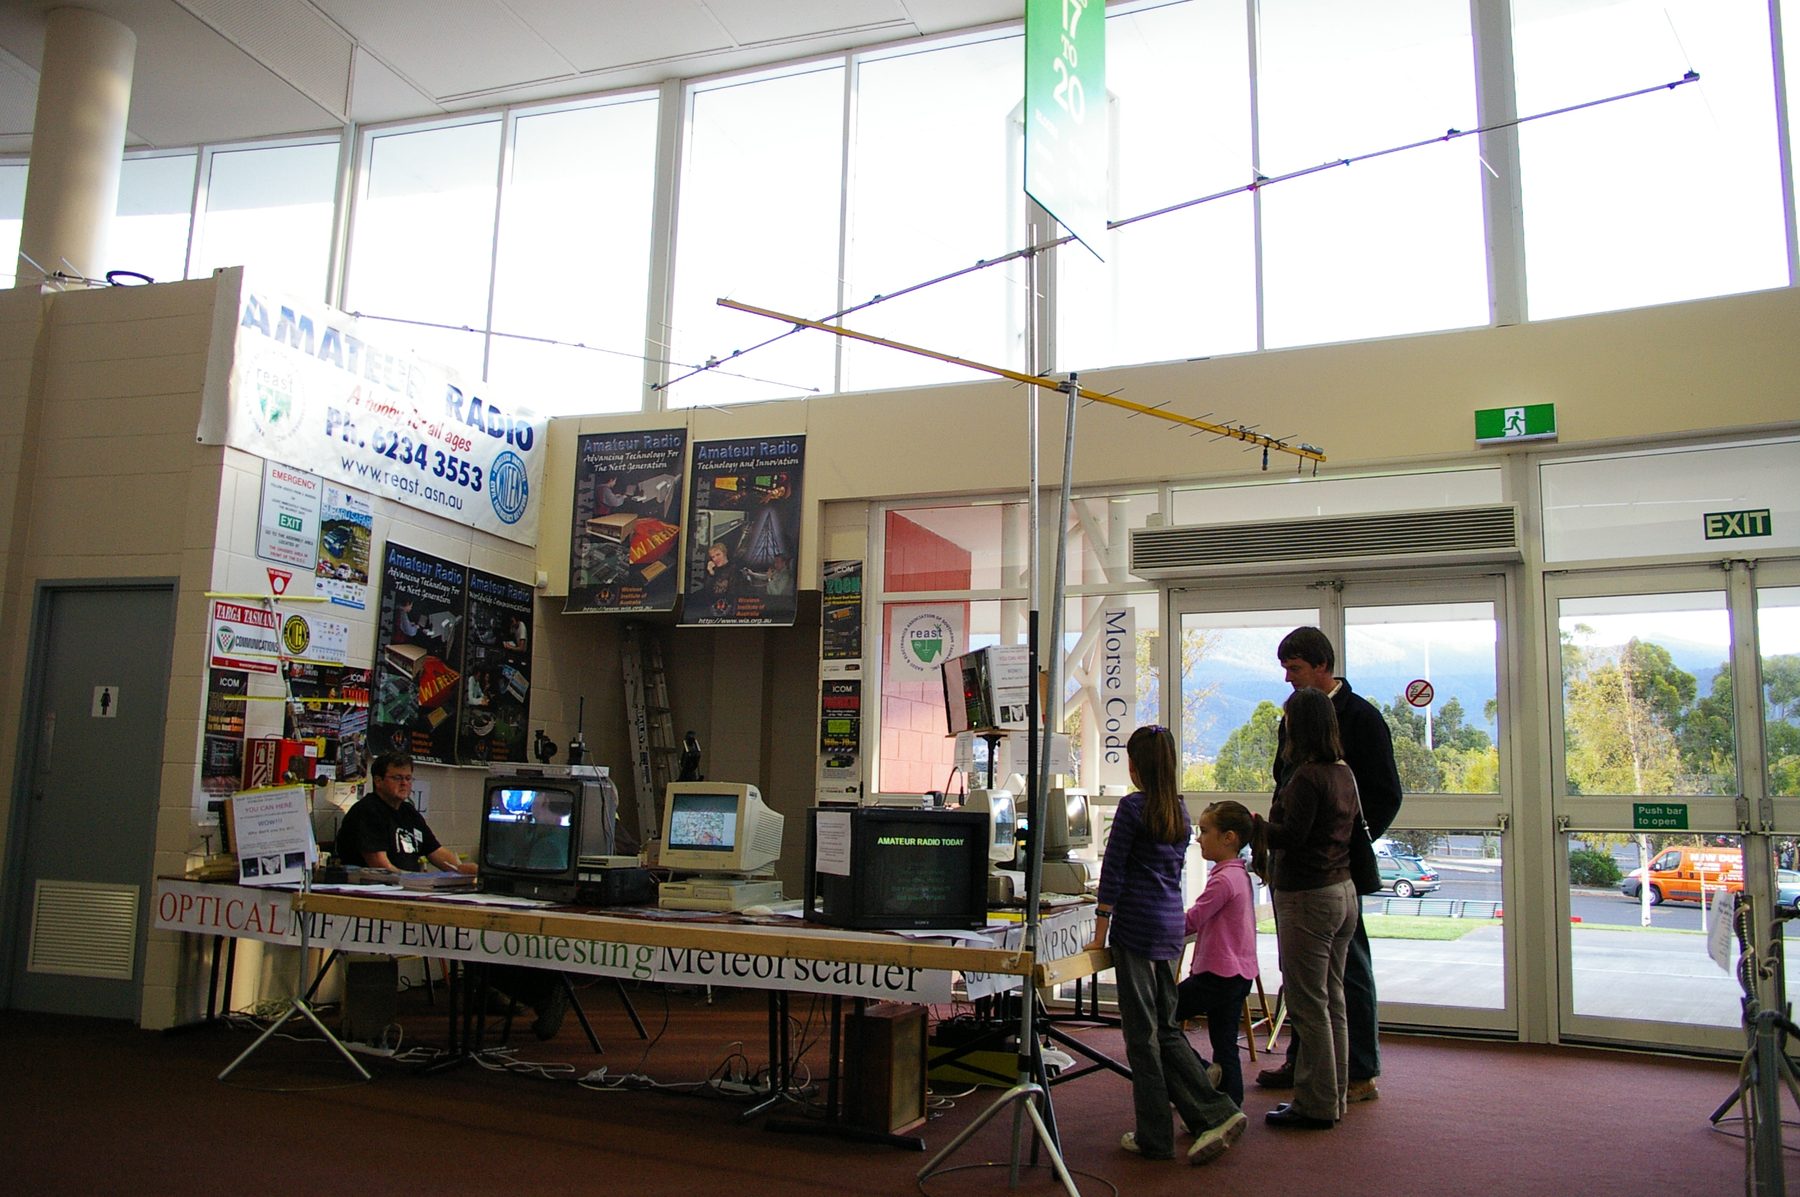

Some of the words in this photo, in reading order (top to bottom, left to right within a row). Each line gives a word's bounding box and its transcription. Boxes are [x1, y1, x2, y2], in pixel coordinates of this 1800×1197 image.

[447, 383, 534, 451] RADIO
[325, 406, 365, 448] Ph.
[372, 426, 427, 470] 6234
[433, 450, 483, 492] 3553
[445, 431, 472, 452] ages
[584, 438, 640, 452] Amateur
[644, 434, 682, 449] Radio
[698, 444, 756, 460] Amateur
[760, 441, 799, 456] Radio
[584, 452, 624, 464] Advancing
[625, 450, 666, 463] Technology
[667, 450, 680, 458] For
[697, 460, 738, 473] Technology
[740, 458, 755, 470] and
[755, 456, 799, 467] Innovation
[594, 464, 608, 472] The
[608, 463, 626, 471] Next
[626, 462, 668, 474] Generation
[272, 469, 316, 490] EMERGENCY
[340, 456, 463, 511] www.reast.asn.au
[280, 513, 302, 530] EXIT
[1705, 511, 1770, 538] EXIT
[388, 548, 433, 576] Amateur
[435, 562, 462, 584] Radio
[388, 566, 420, 588] Advancing
[420, 576, 451, 597] Technology
[451, 585, 460, 596] For
[470, 574, 506, 595] Amateur
[508, 584, 530, 602] Radio
[395, 581, 406, 592] The
[406, 585, 421, 596] Next
[421, 590, 451, 604] Generation
[216, 604, 241, 624] TARGA
[910, 628, 943, 638] reast
[1105, 609, 1127, 690] Morse
[1105, 698, 1128, 764] Code
[260, 804, 274, 812] CAN
[276, 802, 292, 810] HERE
[1638, 804, 1664, 816] Push
[1667, 806, 1684, 816] bar
[1638, 816, 1648, 826] to
[1650, 817, 1678, 828] open
[877, 836, 916, 846] AMATEUR
[917, 838, 940, 846] RADIO
[158, 890, 287, 936] OPTICAL
[479, 928, 655, 980] Contesting
[658, 946, 923, 993] Meteorscatter
